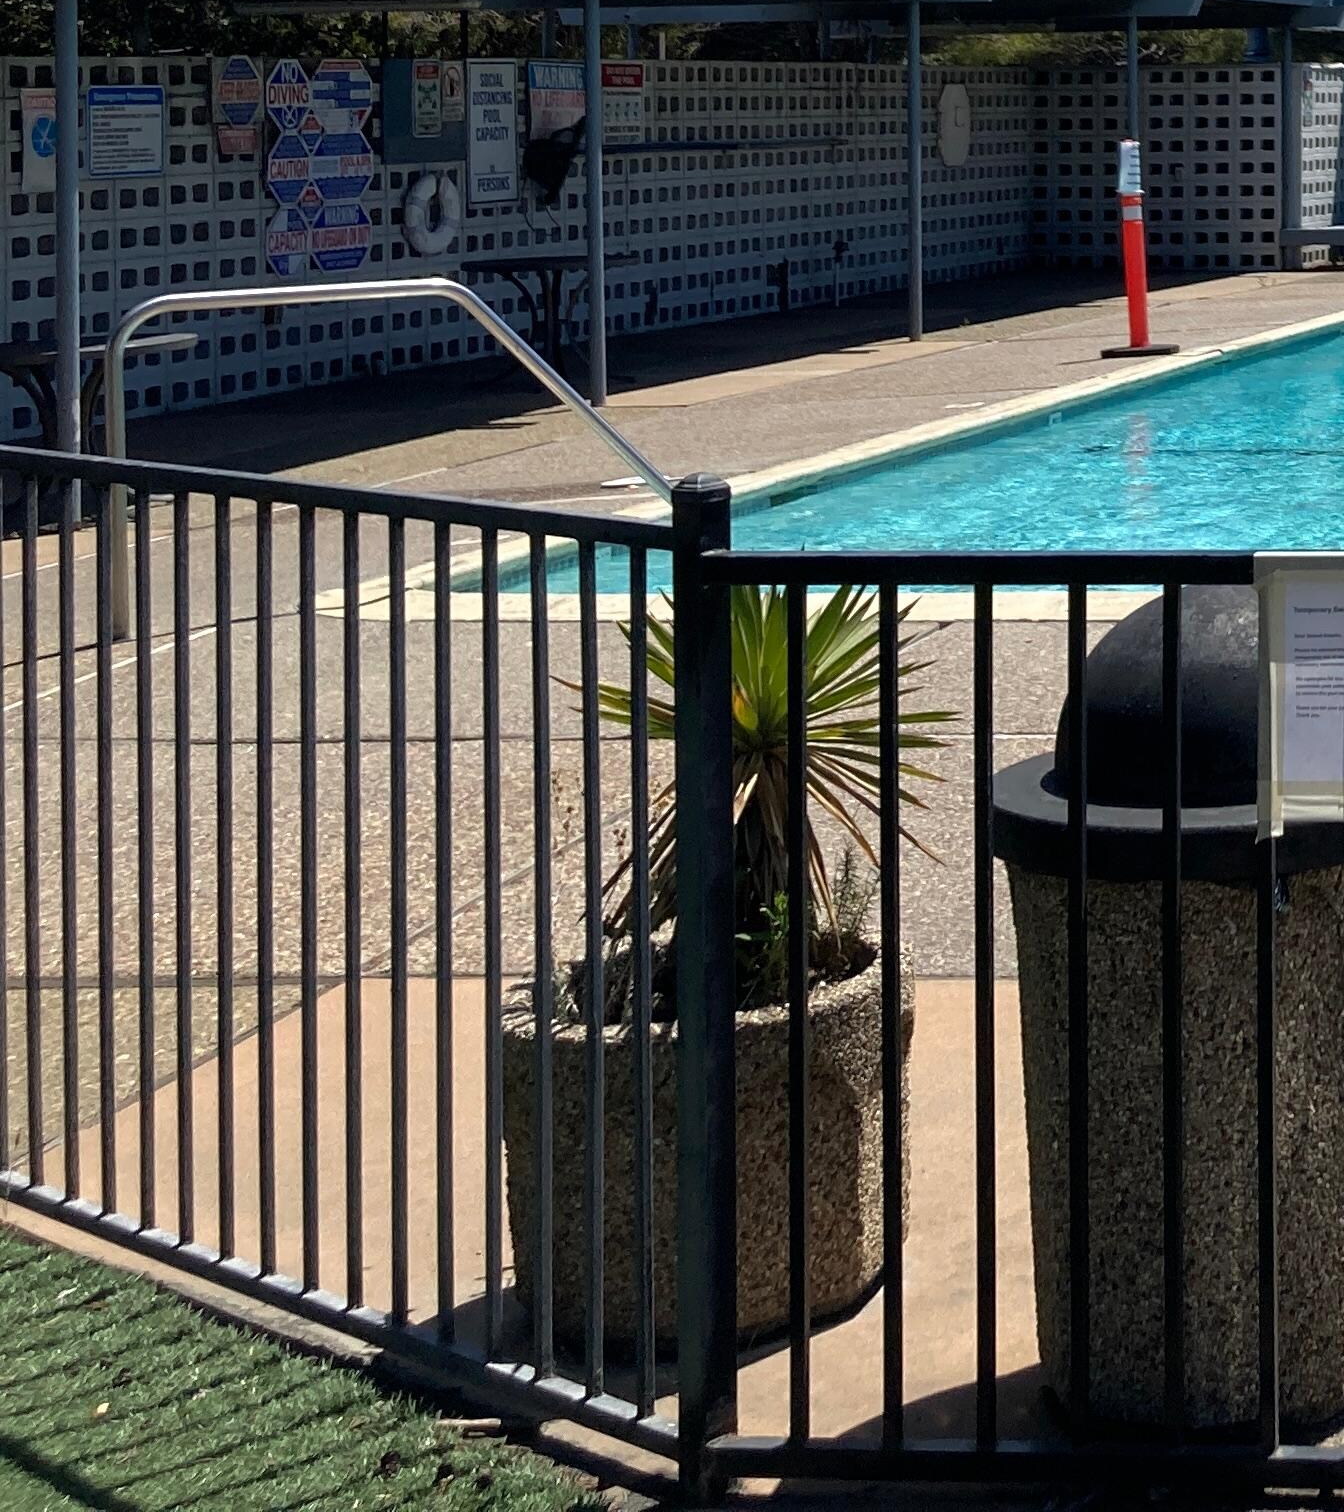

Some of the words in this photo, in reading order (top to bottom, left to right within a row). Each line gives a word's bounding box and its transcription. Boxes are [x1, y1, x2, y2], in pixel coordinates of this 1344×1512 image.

[281, 62, 298, 83] NO
[480, 73, 504, 88] SOCIAL
[269, 85, 309, 105] DIVING
[475, 126, 509, 141] CAPACITY
[271, 157, 309, 180] CAUTION
[477, 176, 510, 193] PERSONS
[269, 230, 307, 255] CAPACITY
